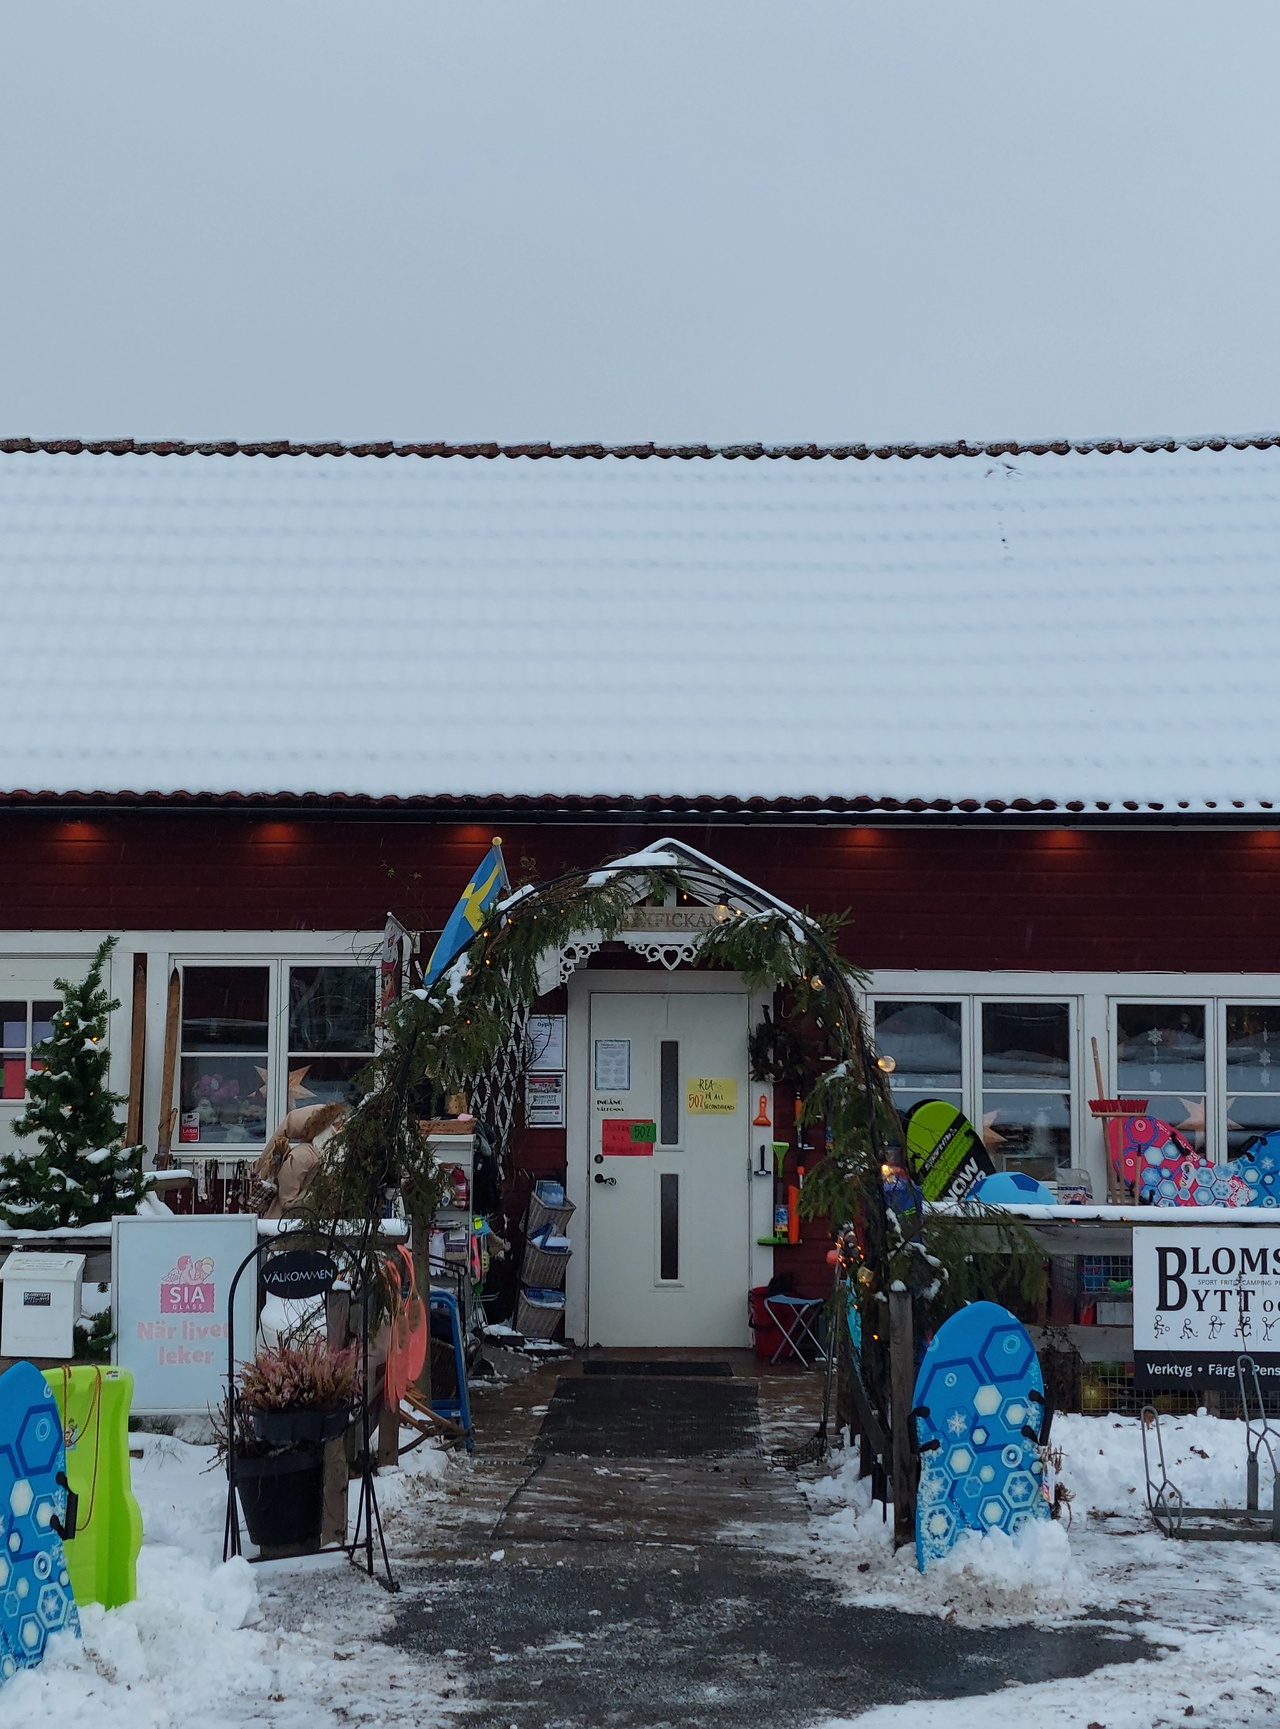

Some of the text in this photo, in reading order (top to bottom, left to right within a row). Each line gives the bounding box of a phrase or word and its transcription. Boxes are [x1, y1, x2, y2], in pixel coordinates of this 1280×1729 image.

[698, 1079, 713, 1091] REA
[263, 1269, 334, 1284] VÄLKOMMEN
[170, 1286, 205, 1303] SIA
[137, 1321, 177, 1340] När
[159, 1344, 215, 1365] leker
[1147, 1363, 1193, 1379] Verktyg
[1208, 1363, 1236, 1379] Färg
